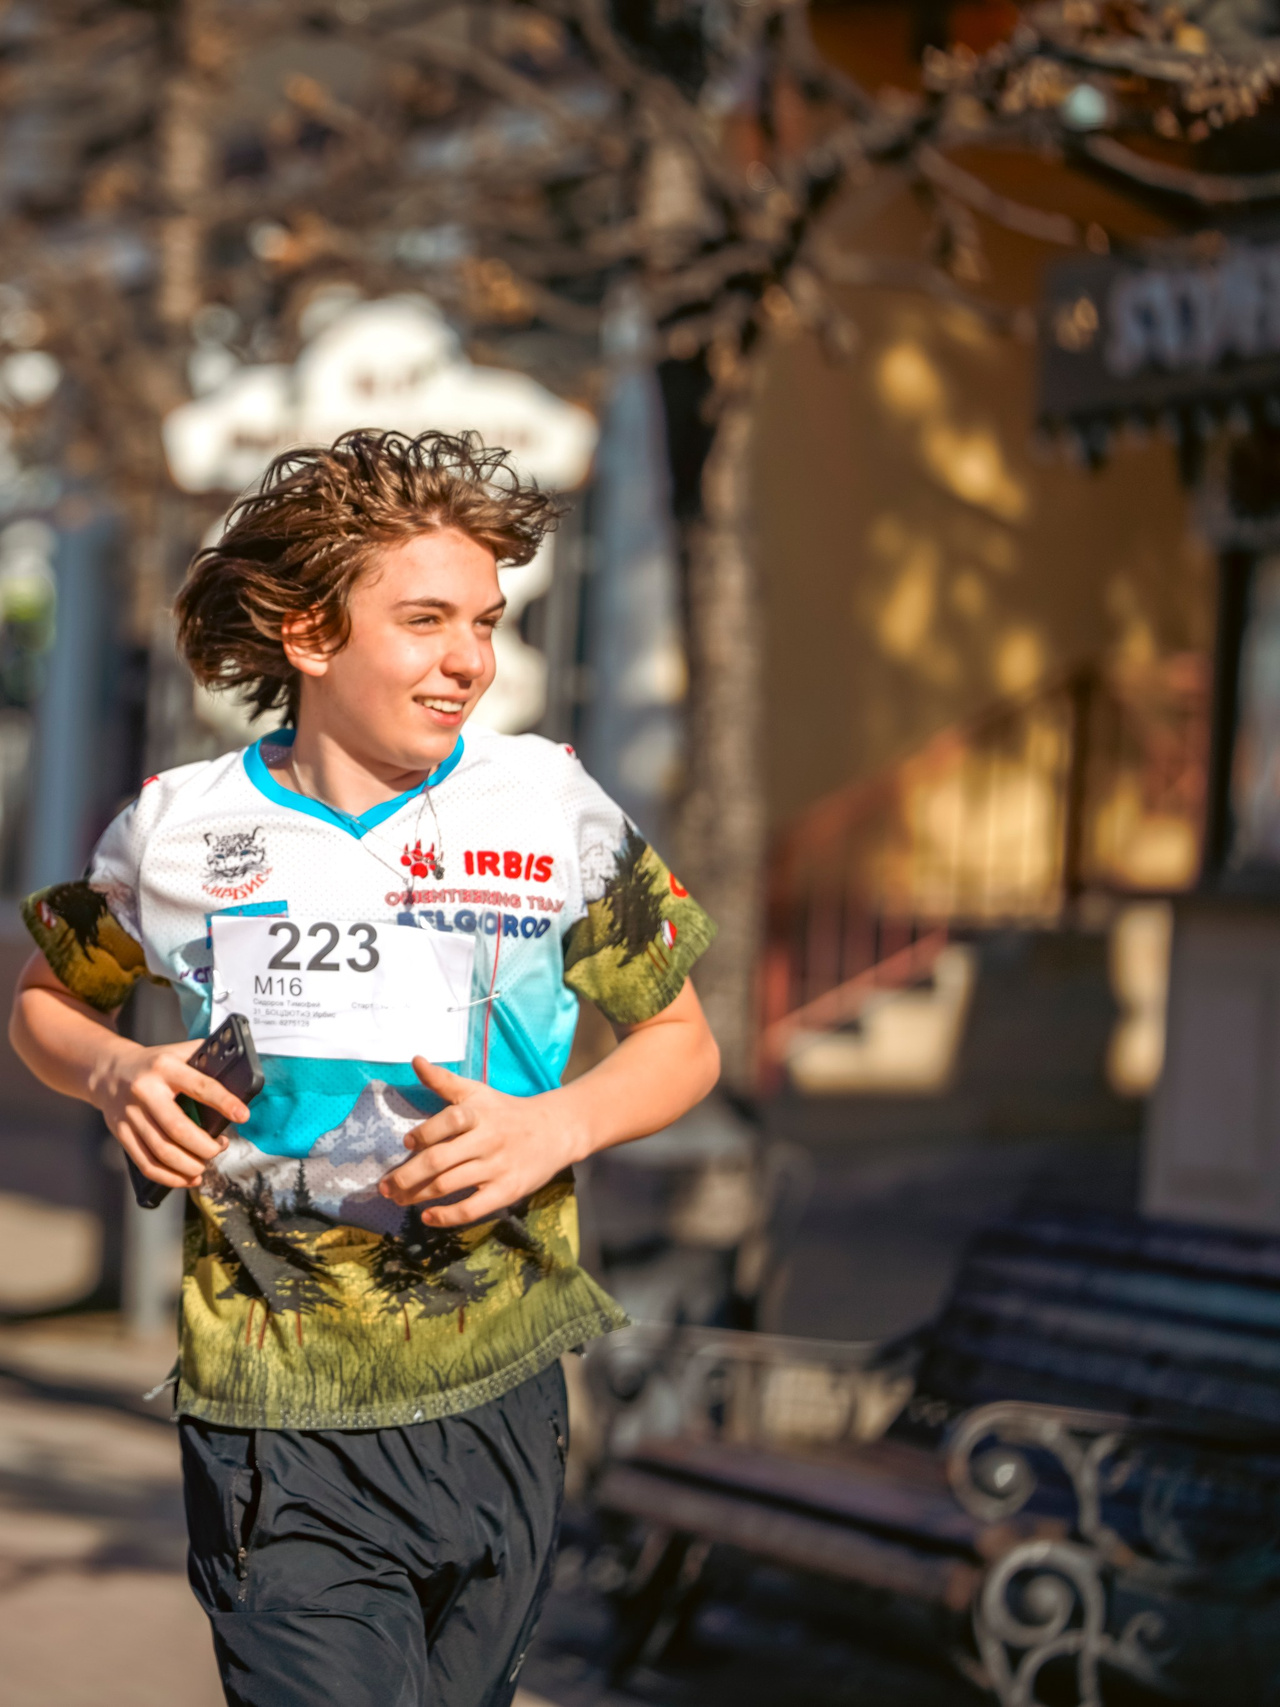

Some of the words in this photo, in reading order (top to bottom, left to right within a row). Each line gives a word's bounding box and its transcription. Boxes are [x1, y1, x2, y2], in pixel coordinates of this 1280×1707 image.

[464, 850, 554, 883] IRBIS
[268, 921, 380, 973] 223
[254, 975, 303, 996] M16
